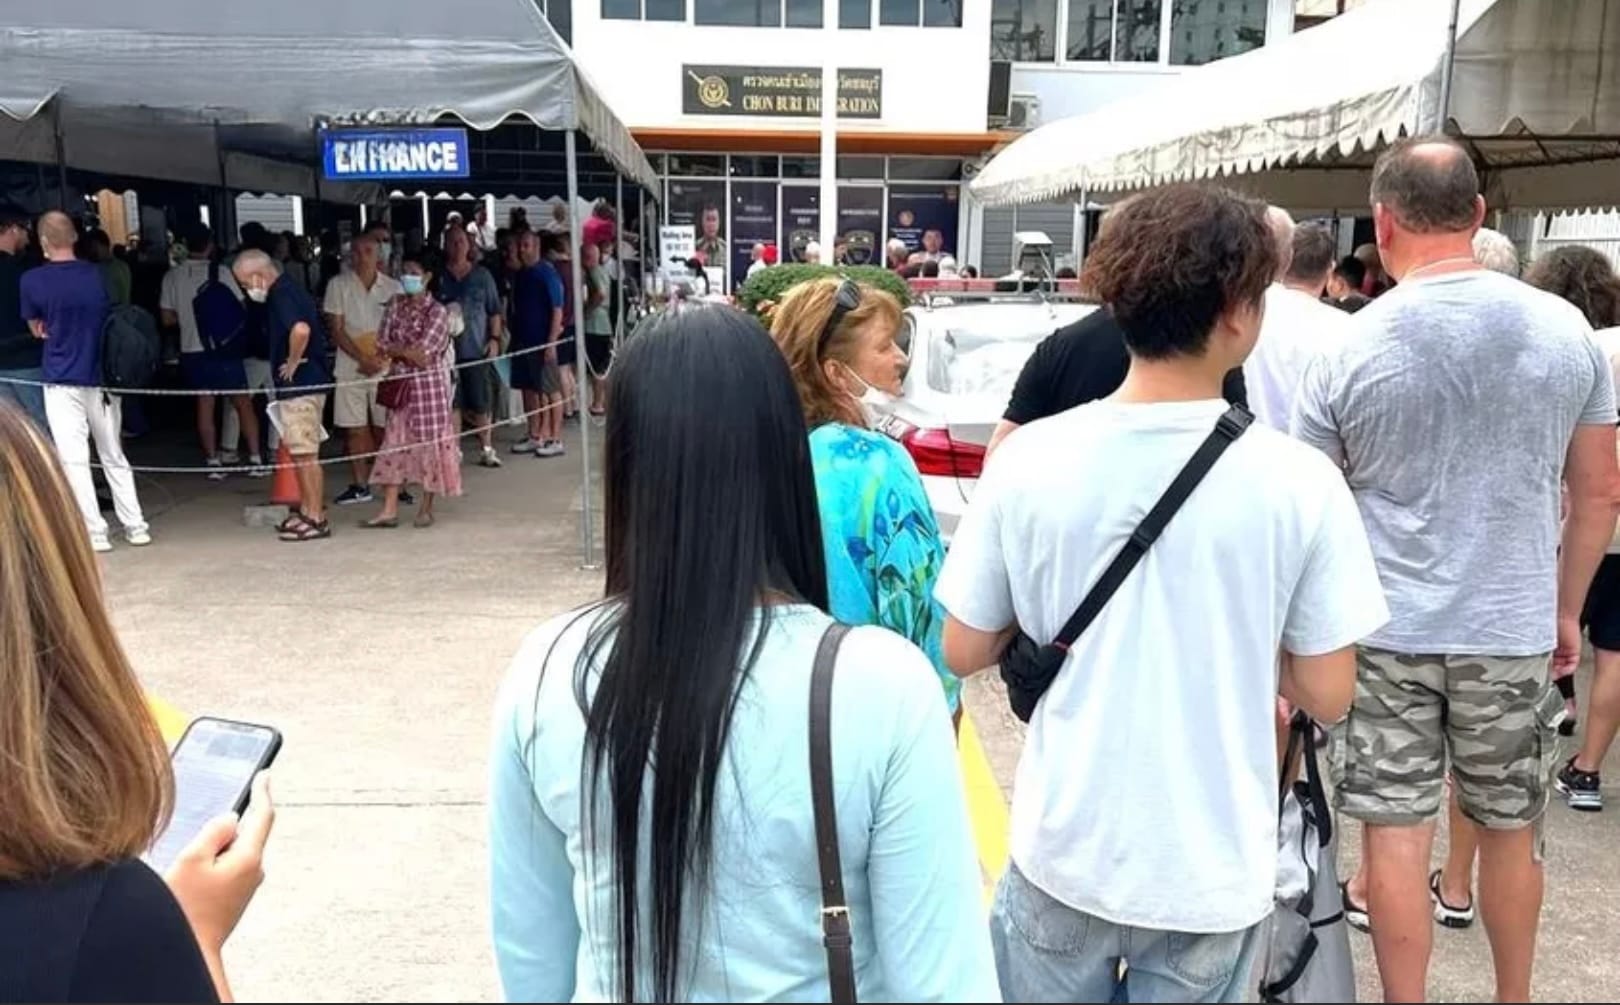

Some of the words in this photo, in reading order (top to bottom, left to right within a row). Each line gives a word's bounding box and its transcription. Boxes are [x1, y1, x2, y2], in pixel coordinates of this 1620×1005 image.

[743, 95, 773, 112] CHON
[776, 96, 801, 112] BURI
[334, 140, 459, 173] ENTRANCE
